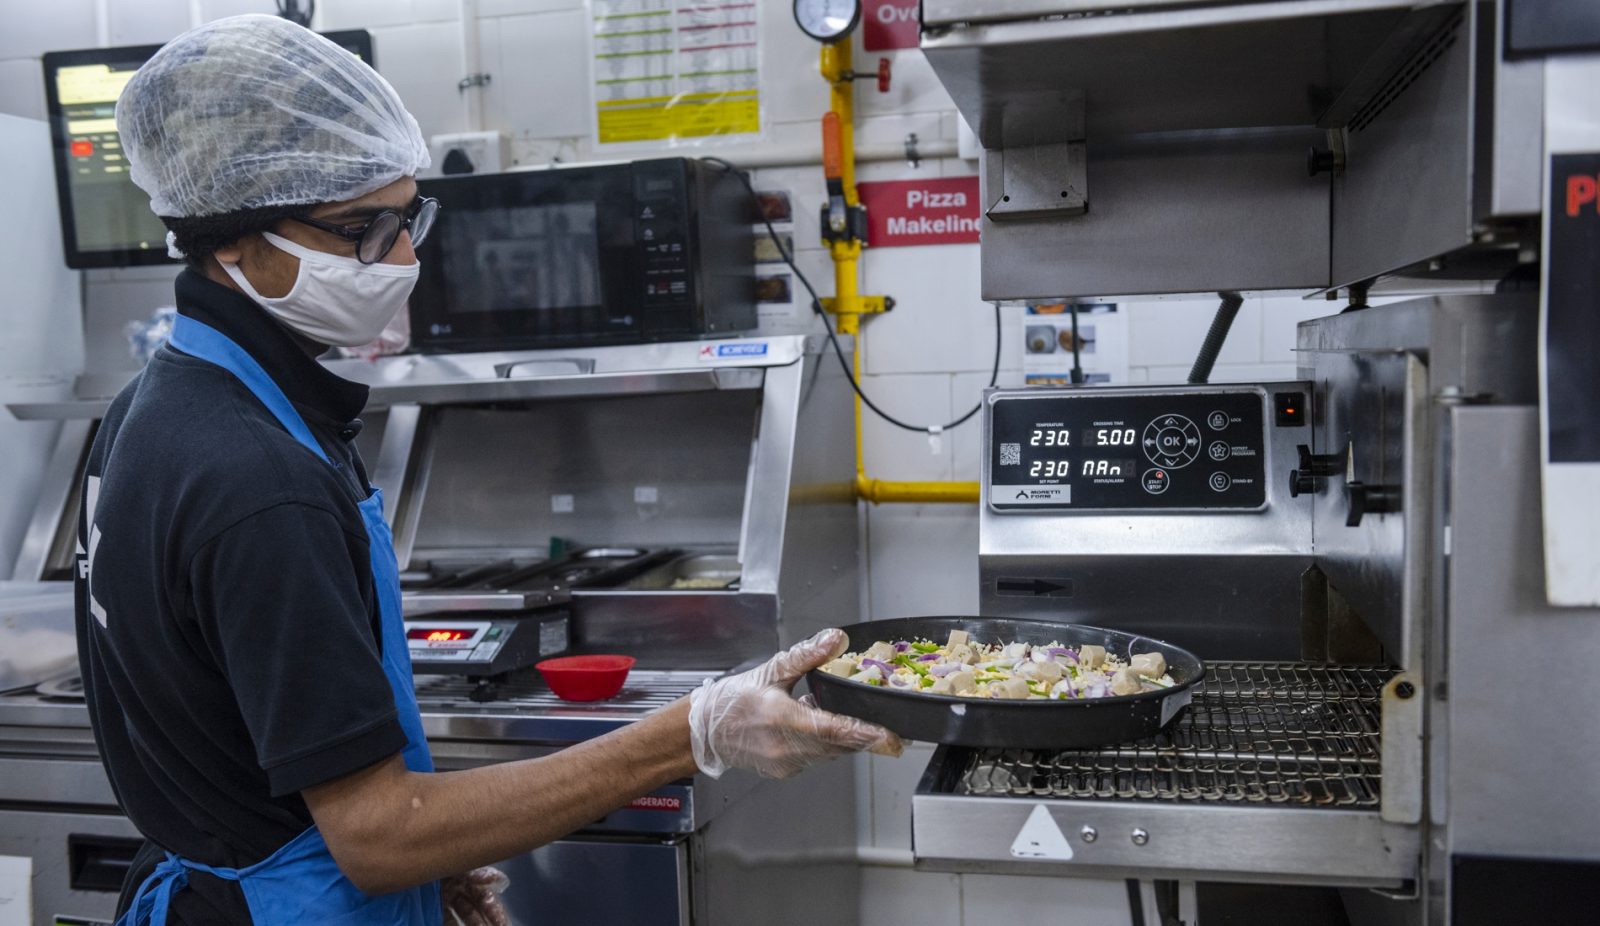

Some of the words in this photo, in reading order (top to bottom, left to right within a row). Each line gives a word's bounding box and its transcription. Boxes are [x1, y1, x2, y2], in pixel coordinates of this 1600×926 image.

[907, 190, 966, 208] Pizza
[1567, 172, 1600, 217] P
[1097, 429, 1135, 446] 5.00
[1163, 437, 1180, 446] OK
[1030, 461, 1069, 477] 230
